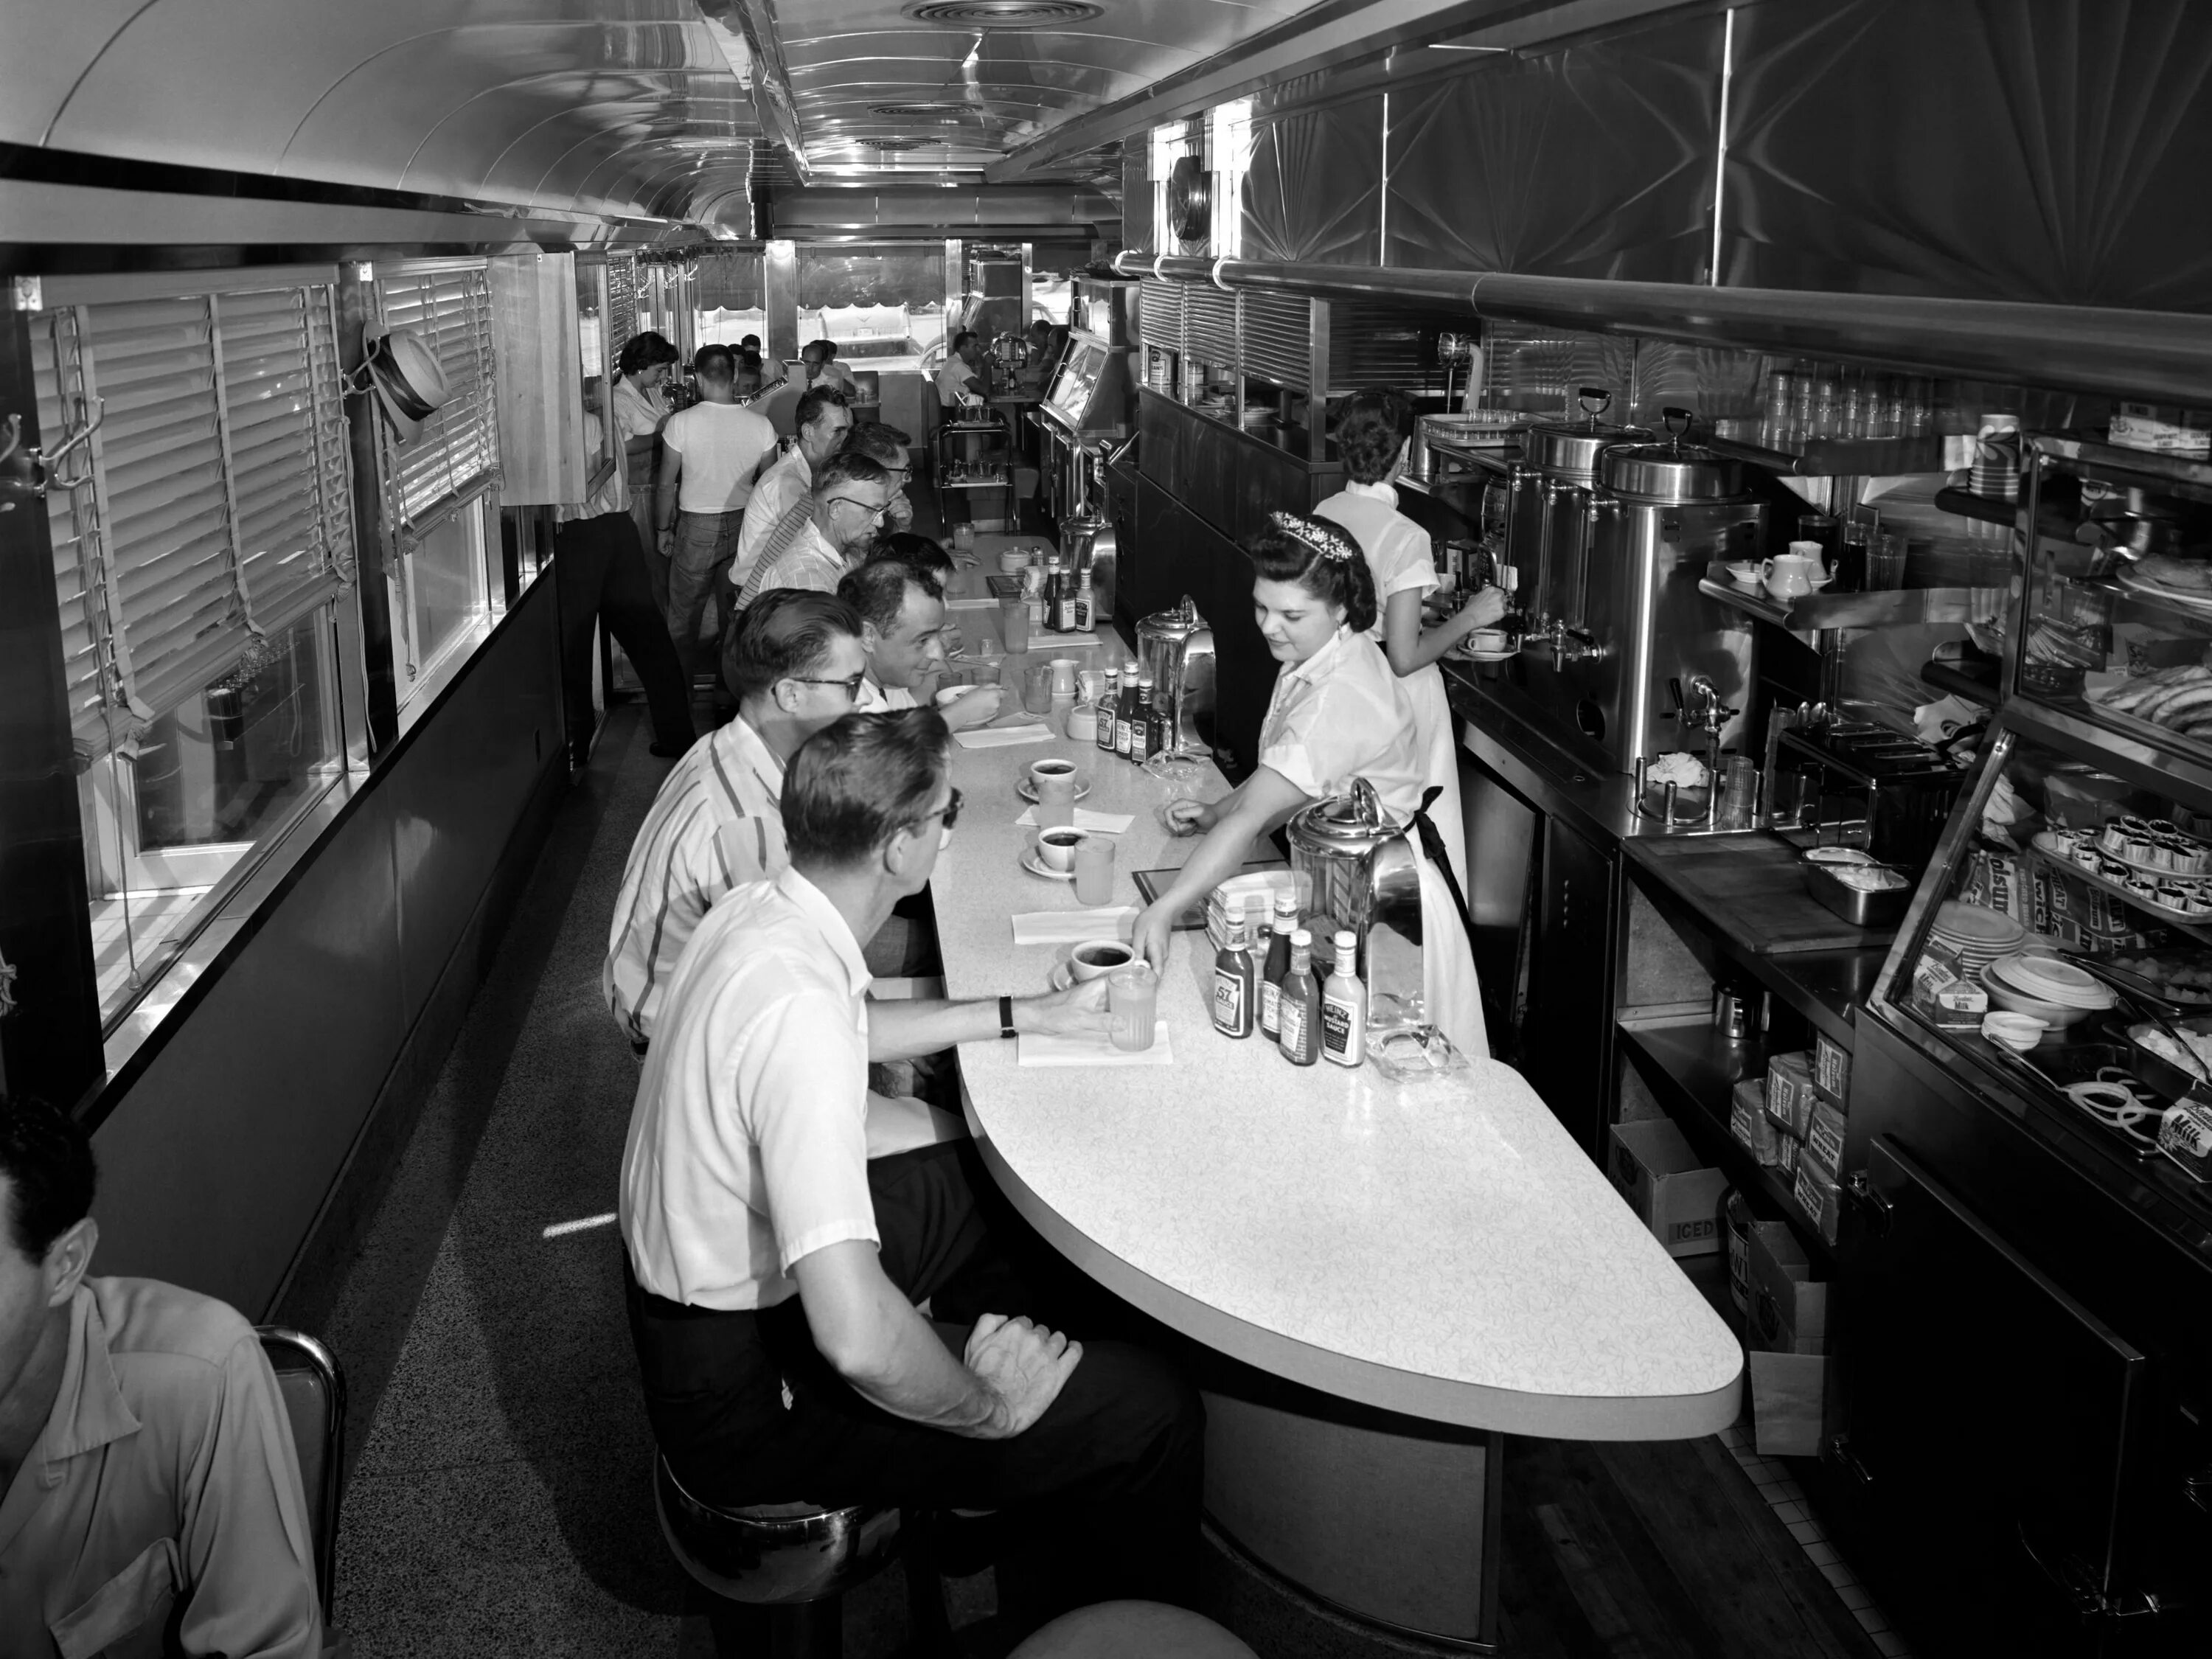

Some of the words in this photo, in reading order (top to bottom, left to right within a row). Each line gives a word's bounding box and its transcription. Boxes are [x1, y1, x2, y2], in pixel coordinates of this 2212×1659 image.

[1216, 987, 1233, 1001] 57
[1326, 1022, 1346, 1034] SAUCE
[2171, 1113, 2201, 1152] Milk
[1812, 1134, 1836, 1161] WHEAT
[1676, 1220, 1714, 1239] ICED
